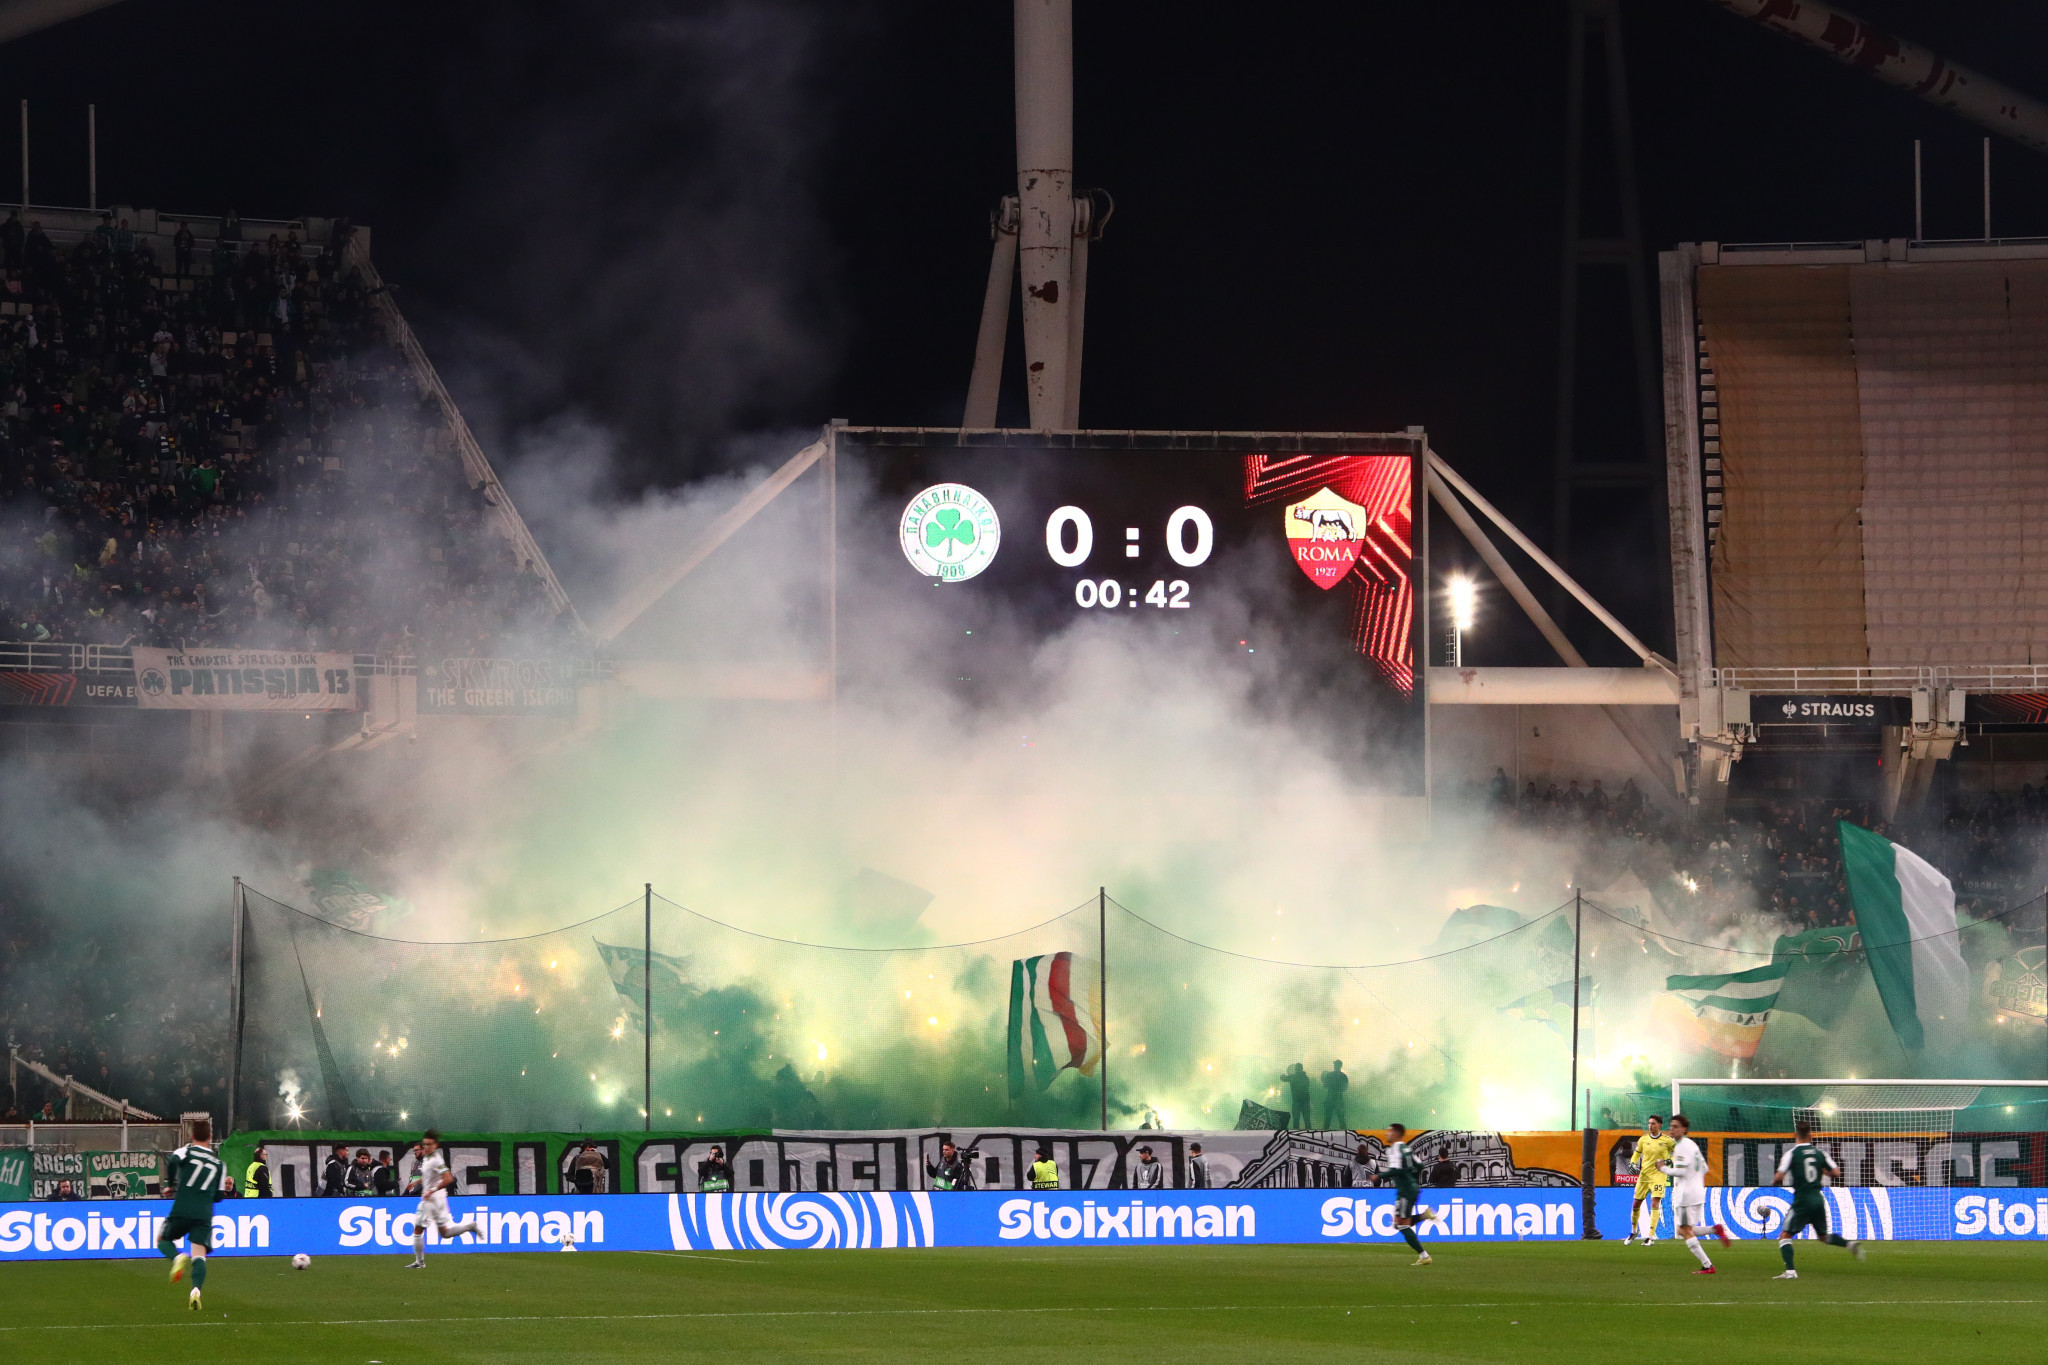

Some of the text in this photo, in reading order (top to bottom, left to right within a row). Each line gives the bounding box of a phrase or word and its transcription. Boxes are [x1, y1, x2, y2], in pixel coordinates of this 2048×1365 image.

[1045, 505, 1094, 568] 0
[1166, 505, 1214, 568] 0
[1298, 546, 1354, 562] ROMA
[936, 563, 965, 578] 1908
[1315, 567, 1336, 577] 1927
[1075, 578, 1191, 609] 00:42
[167, 654, 317, 666] THE EMPIRE STRIKES BACK
[169, 667, 350, 695] PATISSIA 13
[442, 658, 552, 689] SKYROS
[86, 685, 123, 697] UEFA
[427, 688, 456, 706] THE
[464, 688, 516, 706] GREEN
[1801, 703, 1875, 717] STRAUSS
[33, 1152, 83, 1174] ARGOS
[91, 1152, 157, 1171] COLONOS
[1803, 1157, 1818, 1183] 6
[185, 1158, 218, 1191] 77
[33, 1179, 60, 1198] GAT
[1653, 1184, 1663, 1192] 95
[998, 1199, 1255, 1240] Stoiximan
